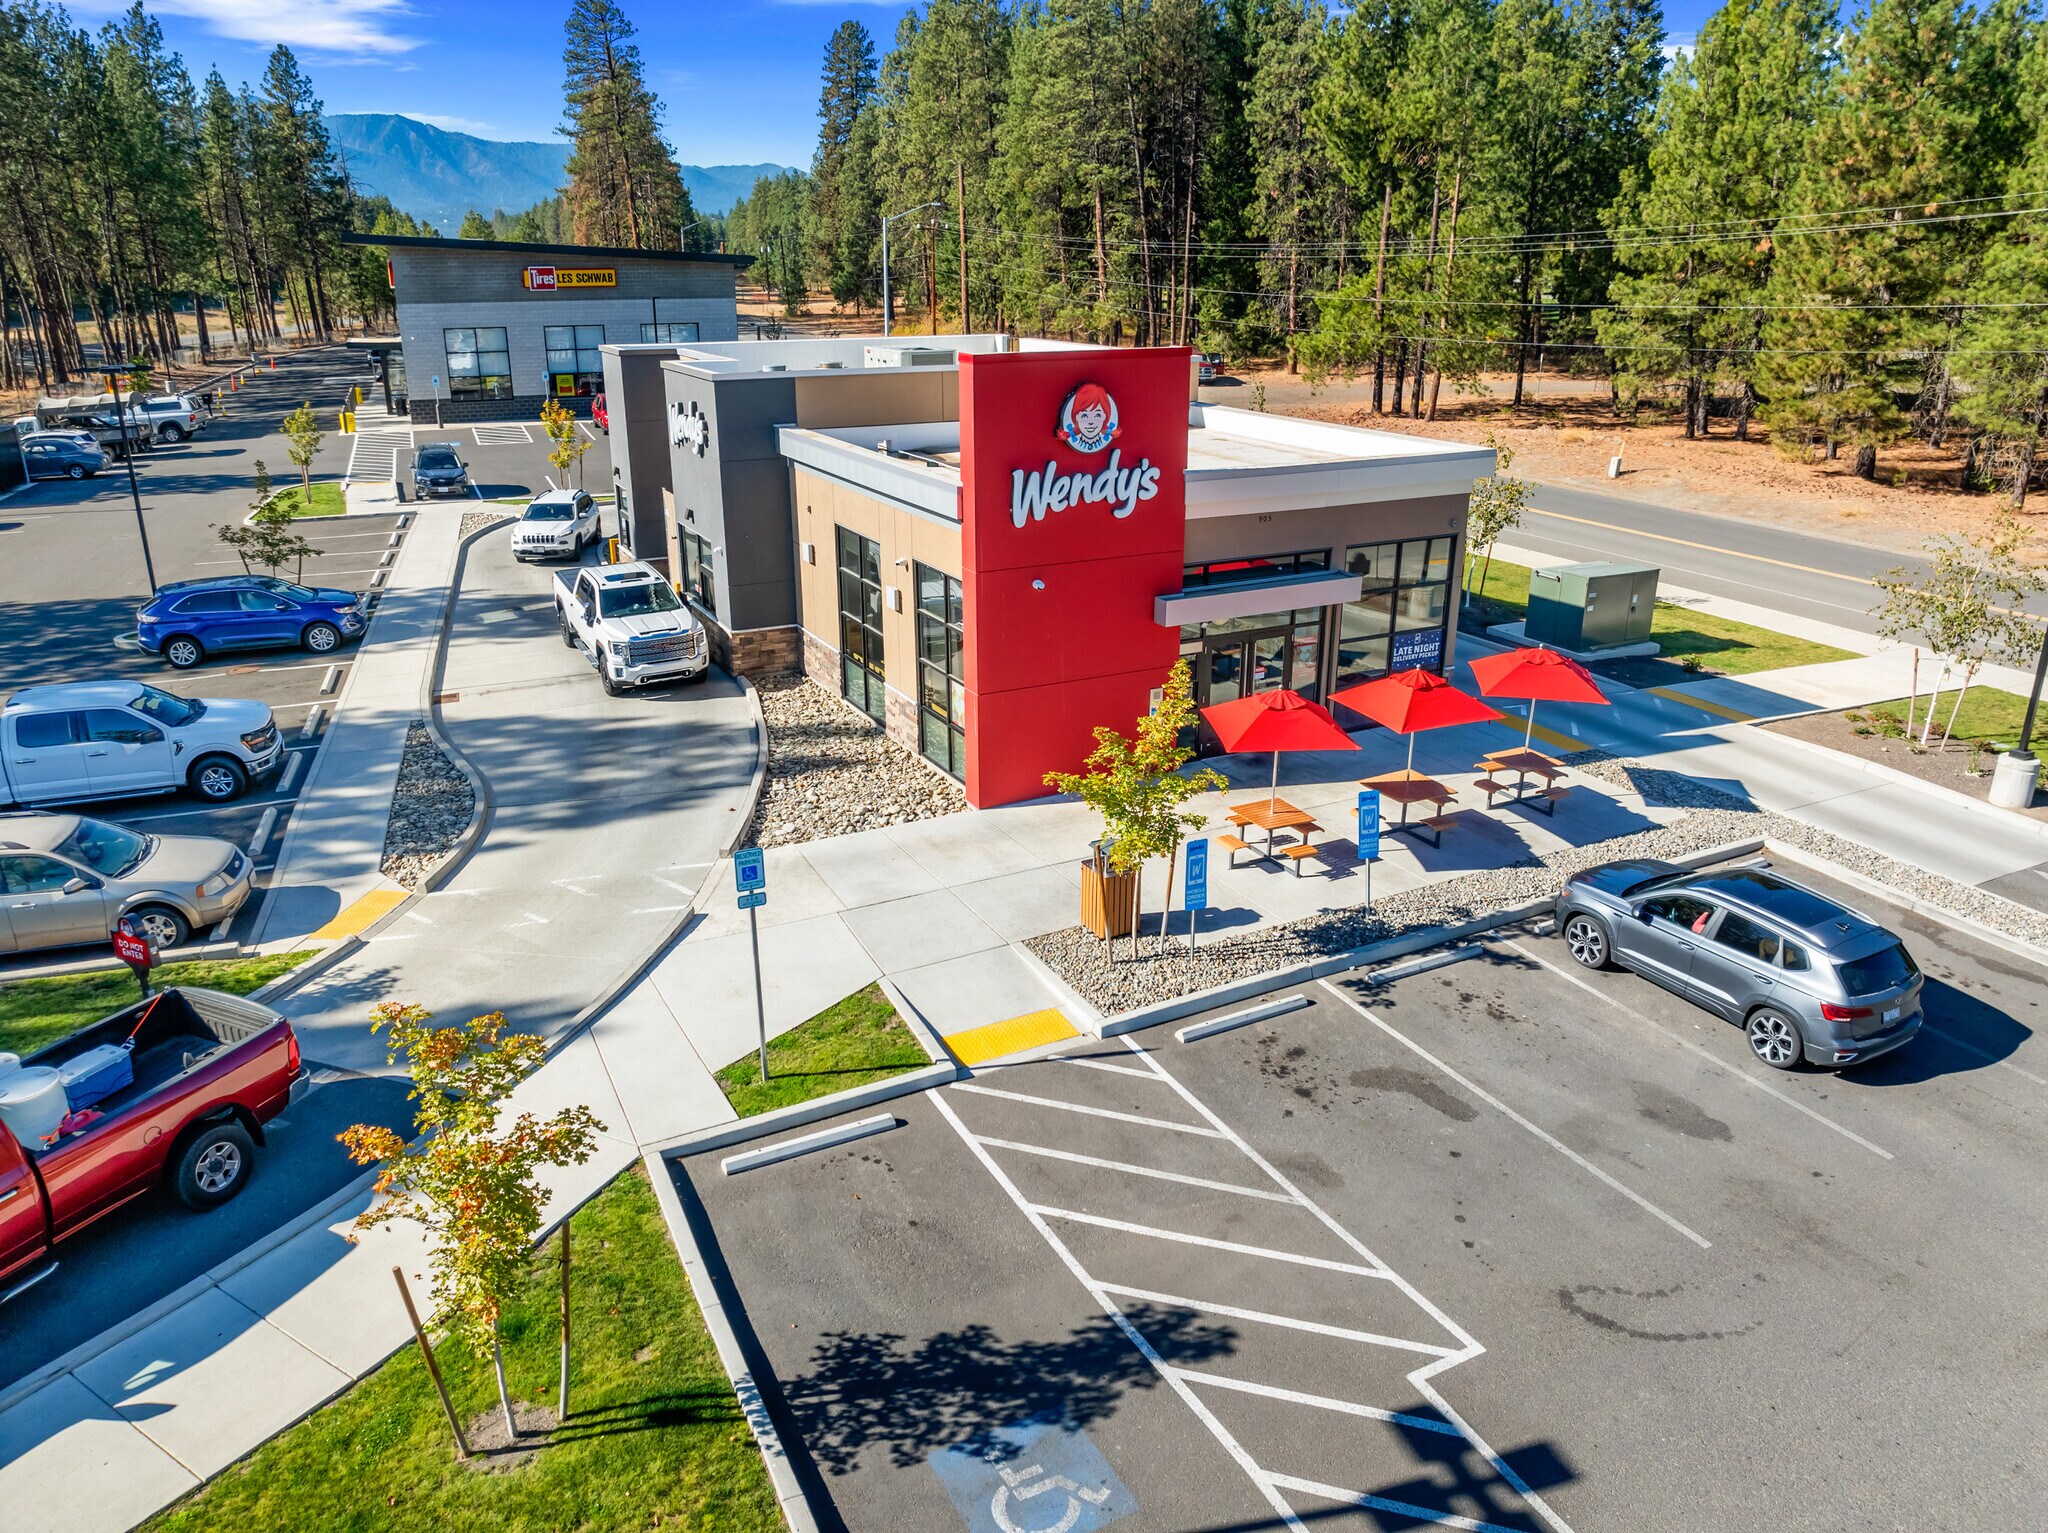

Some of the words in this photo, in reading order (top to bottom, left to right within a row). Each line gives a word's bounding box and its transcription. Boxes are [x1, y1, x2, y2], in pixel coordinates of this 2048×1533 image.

[530, 269, 554, 288] Tires
[557, 273, 573, 284] LES
[576, 273, 613, 284] SCHWAB
[1012, 448, 1160, 528] Wendy's
[1258, 515, 1272, 523] 905
[1393, 645, 1413, 657] LATE
[1413, 642, 1440, 653] NIGHT
[1392, 653, 1418, 662] DELIVERY
[1418, 651, 1439, 659] PICKUP
[736, 850, 761, 859] RESERVED
[738, 858, 760, 866] PARKING
[118, 939, 129, 948] DO
[130, 943, 143, 952] NOT
[122, 948, 144, 960] ENTER
